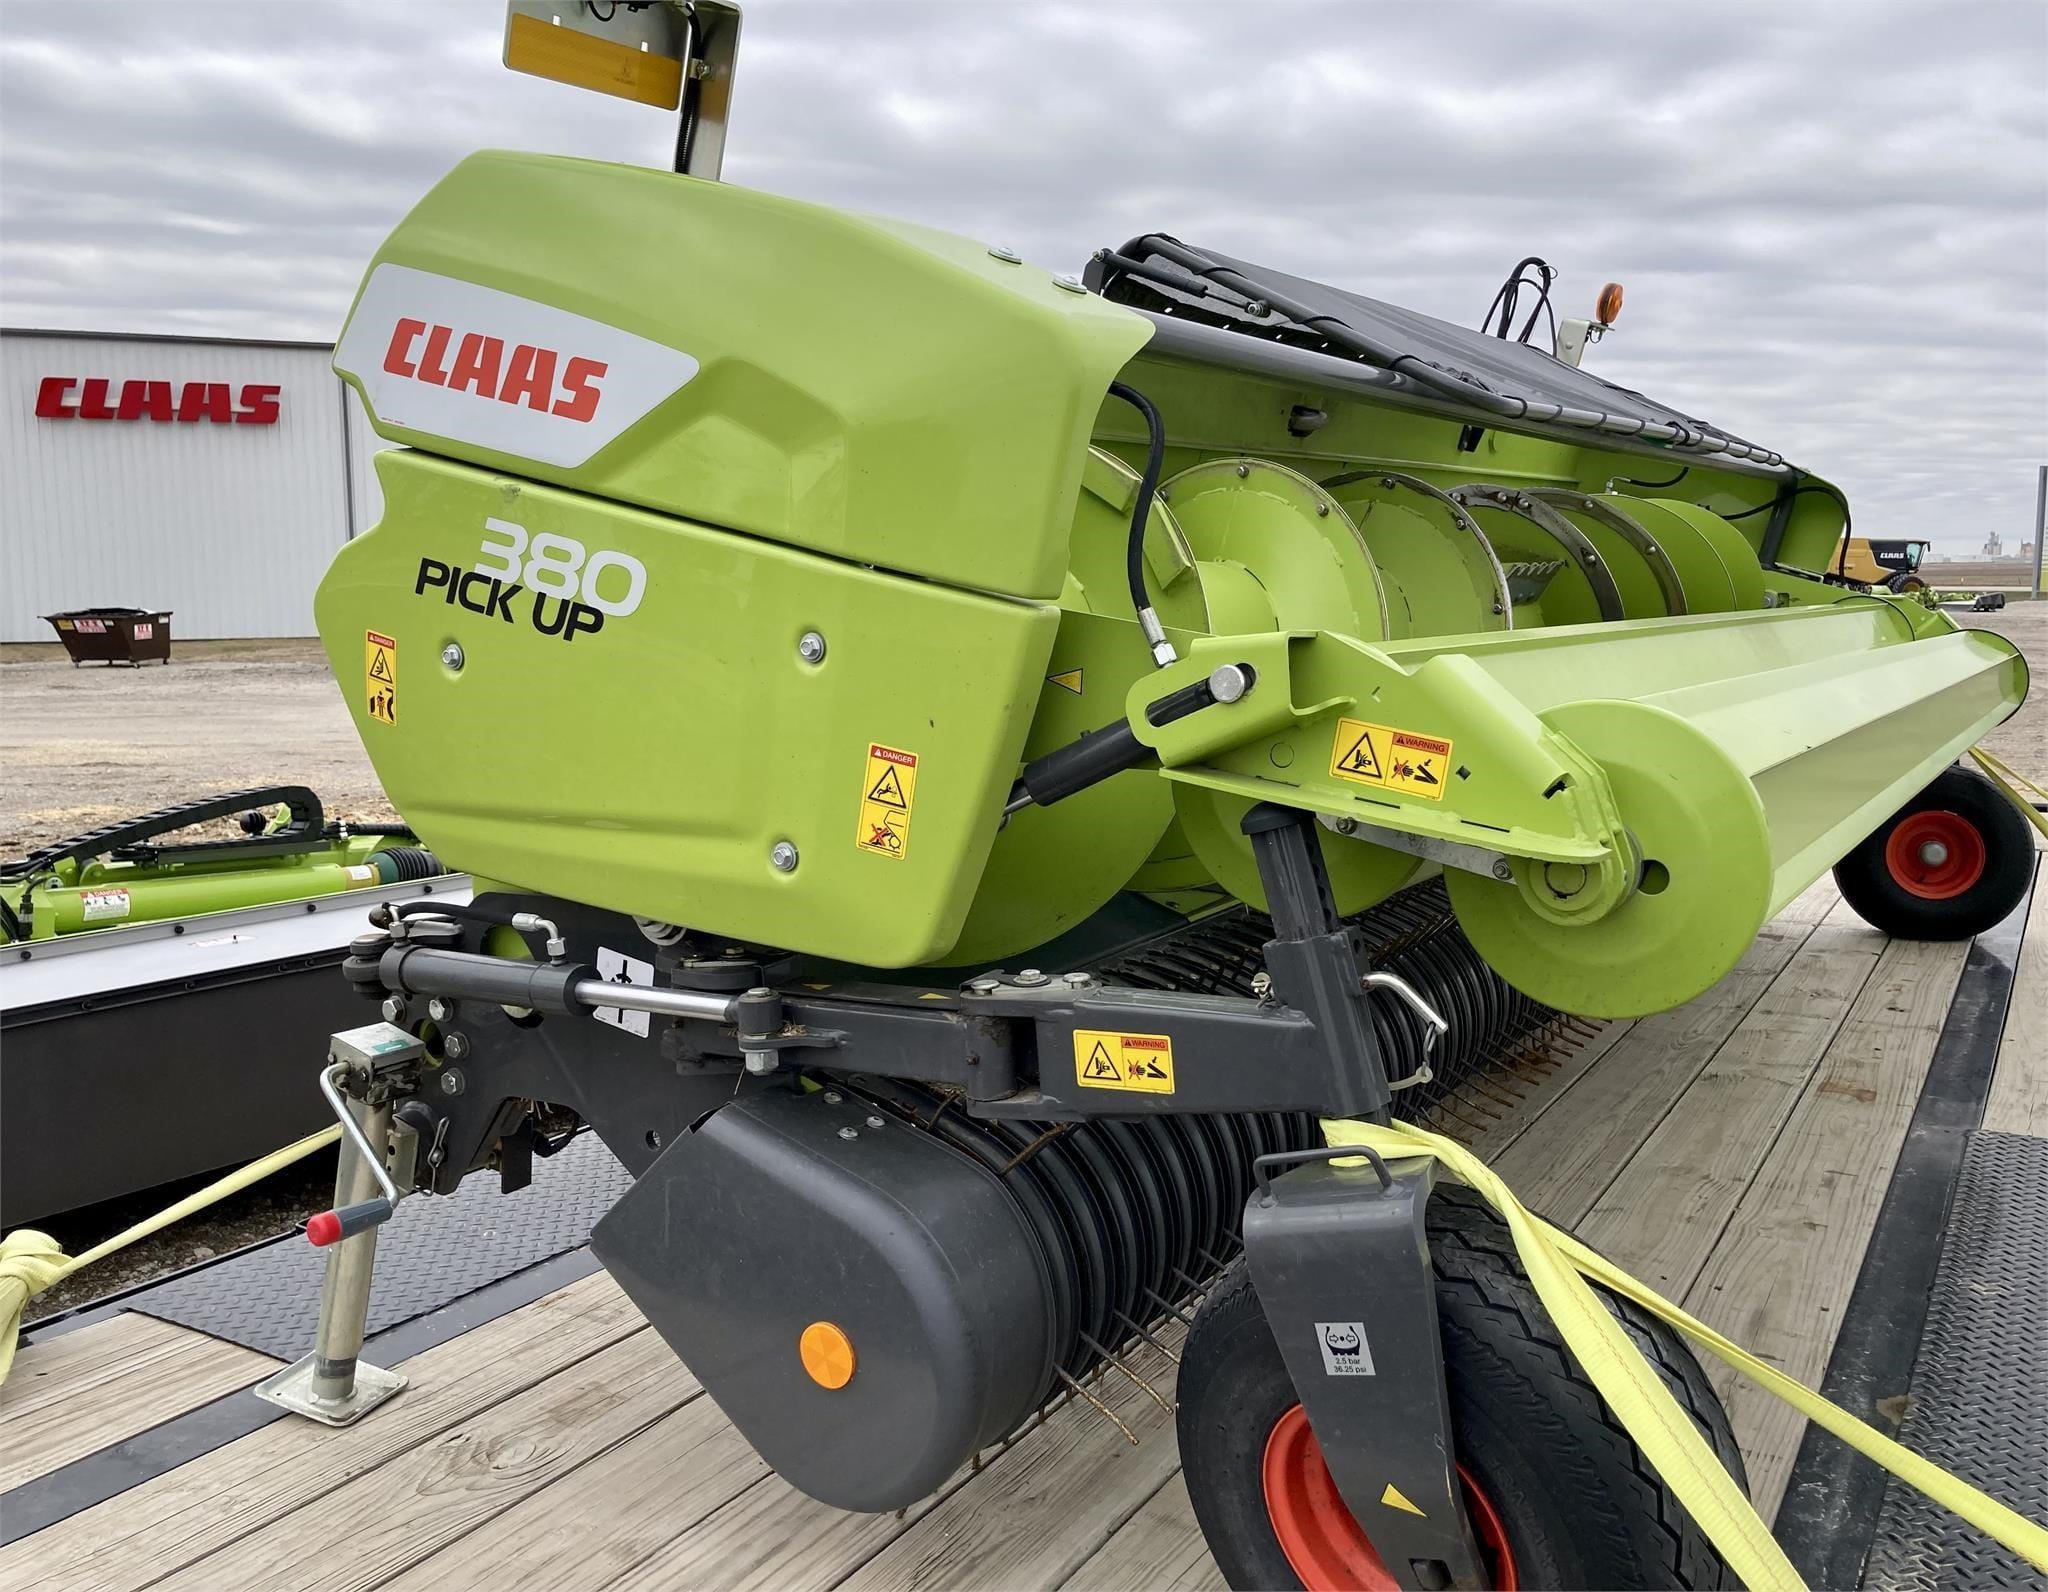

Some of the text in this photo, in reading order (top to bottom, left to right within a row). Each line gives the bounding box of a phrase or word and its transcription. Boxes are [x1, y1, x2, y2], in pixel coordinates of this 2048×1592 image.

[383, 317, 609, 423] CLAAS
[35, 377, 282, 424] CLAAS
[474, 516, 648, 617] 380
[415, 557, 604, 642] PICK UP
[883, 750, 913, 765] DANGER
[1405, 736, 1445, 753] WARNING
[1131, 1039, 1165, 1049] WARNING
[1333, 1365, 1354, 1373] 36.25
